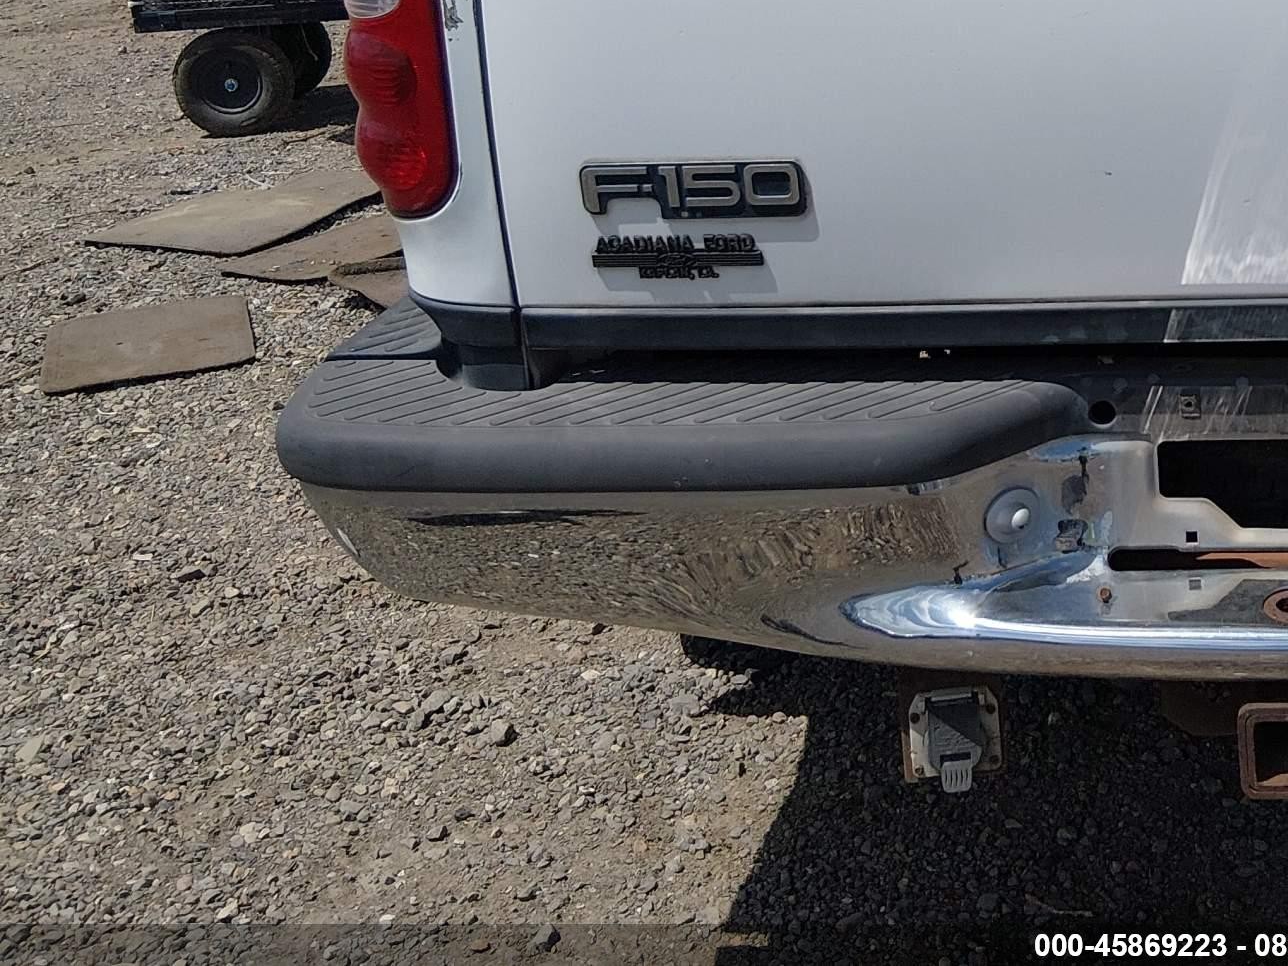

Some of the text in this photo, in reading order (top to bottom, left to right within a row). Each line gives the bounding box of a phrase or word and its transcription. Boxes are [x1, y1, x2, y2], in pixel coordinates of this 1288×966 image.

[579, 164, 802, 214] F-150
[596, 233, 756, 252] ACADIANA FORD
